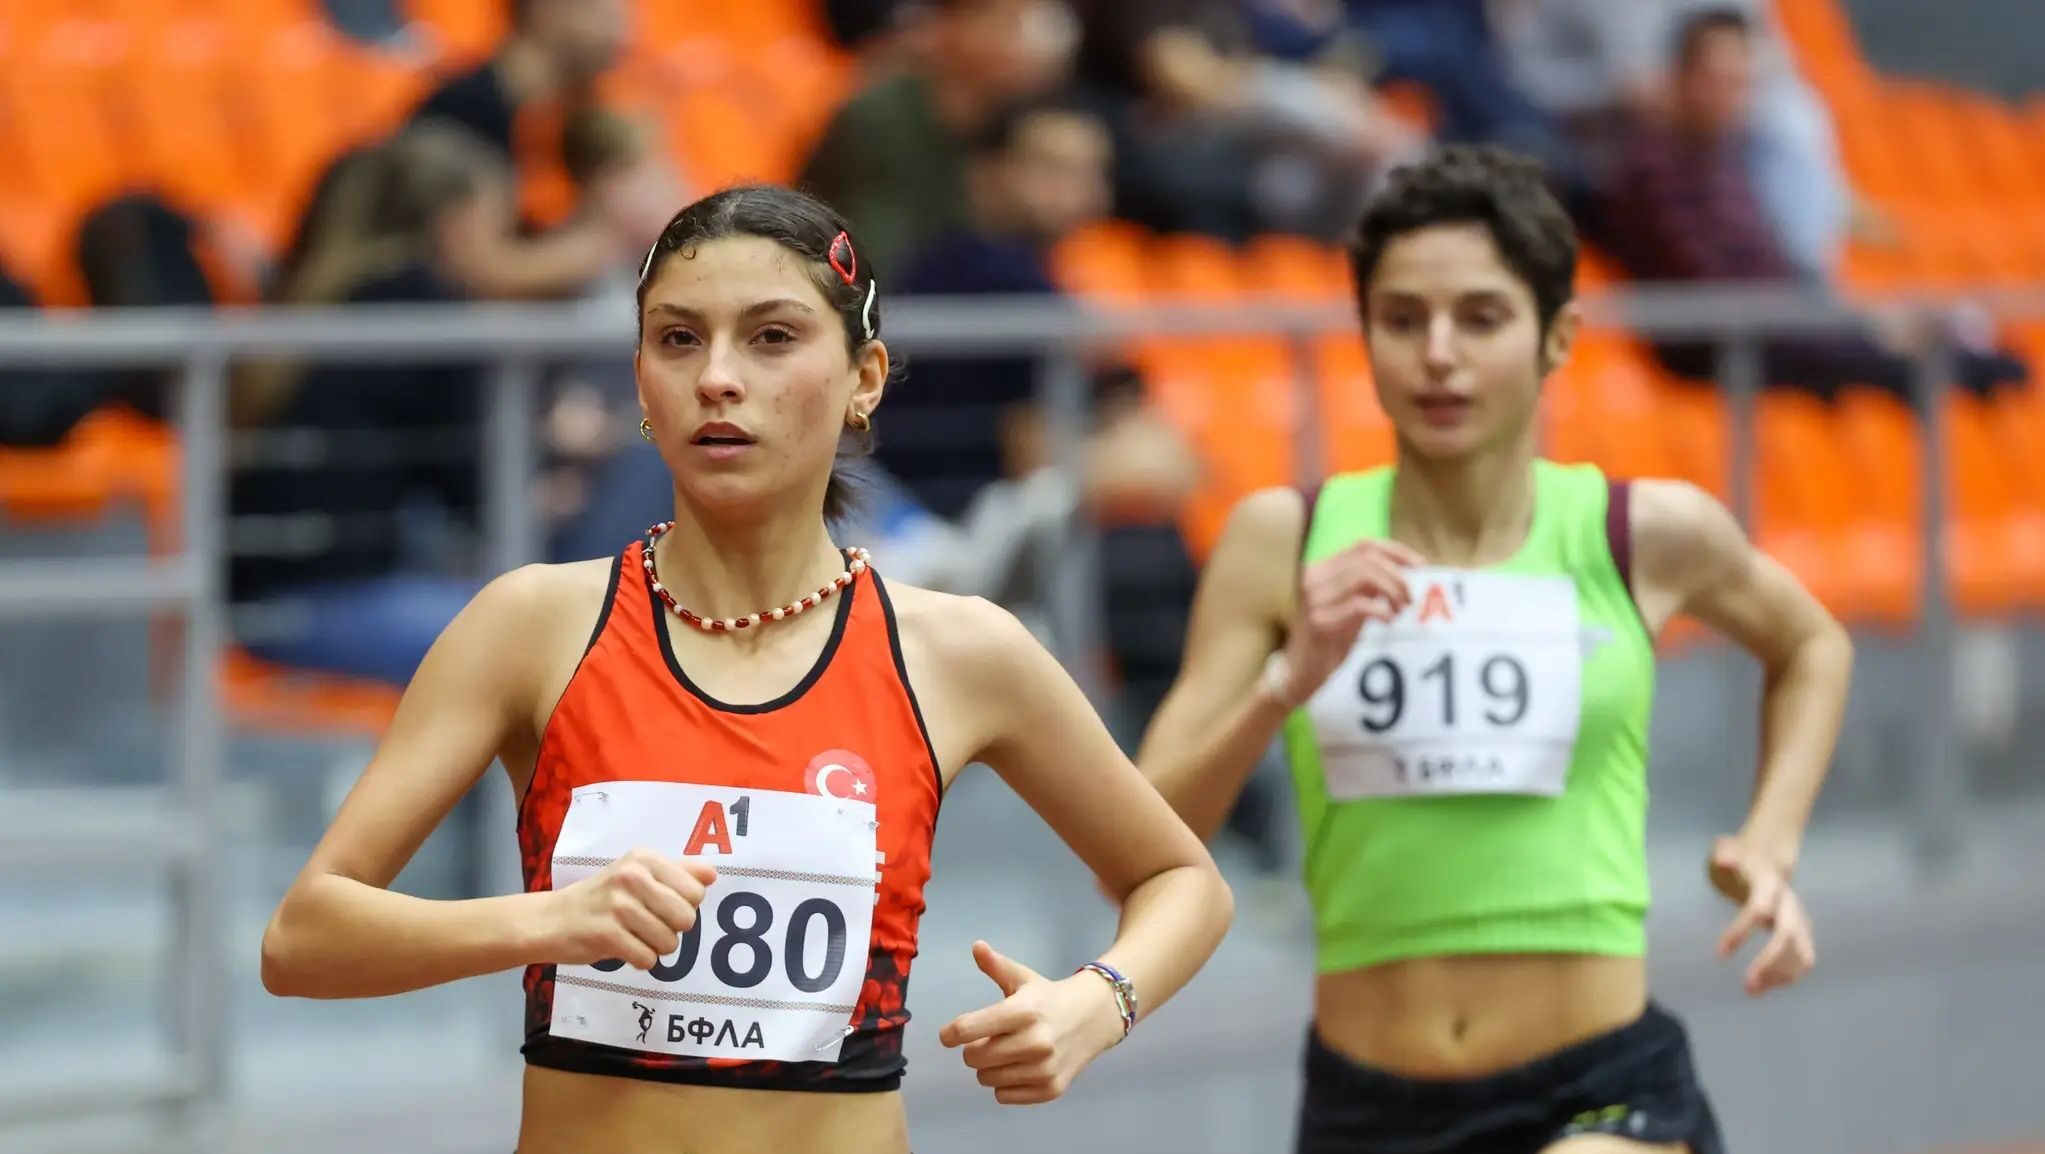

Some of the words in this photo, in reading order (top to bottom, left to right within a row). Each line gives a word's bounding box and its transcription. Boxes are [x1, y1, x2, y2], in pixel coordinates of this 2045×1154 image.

[1418, 581, 1466, 624] A1
[1358, 653, 1530, 733] 919
[683, 796, 750, 855] A1
[588, 891, 847, 993] 080
[666, 1014, 765, 1048] БФЛА
